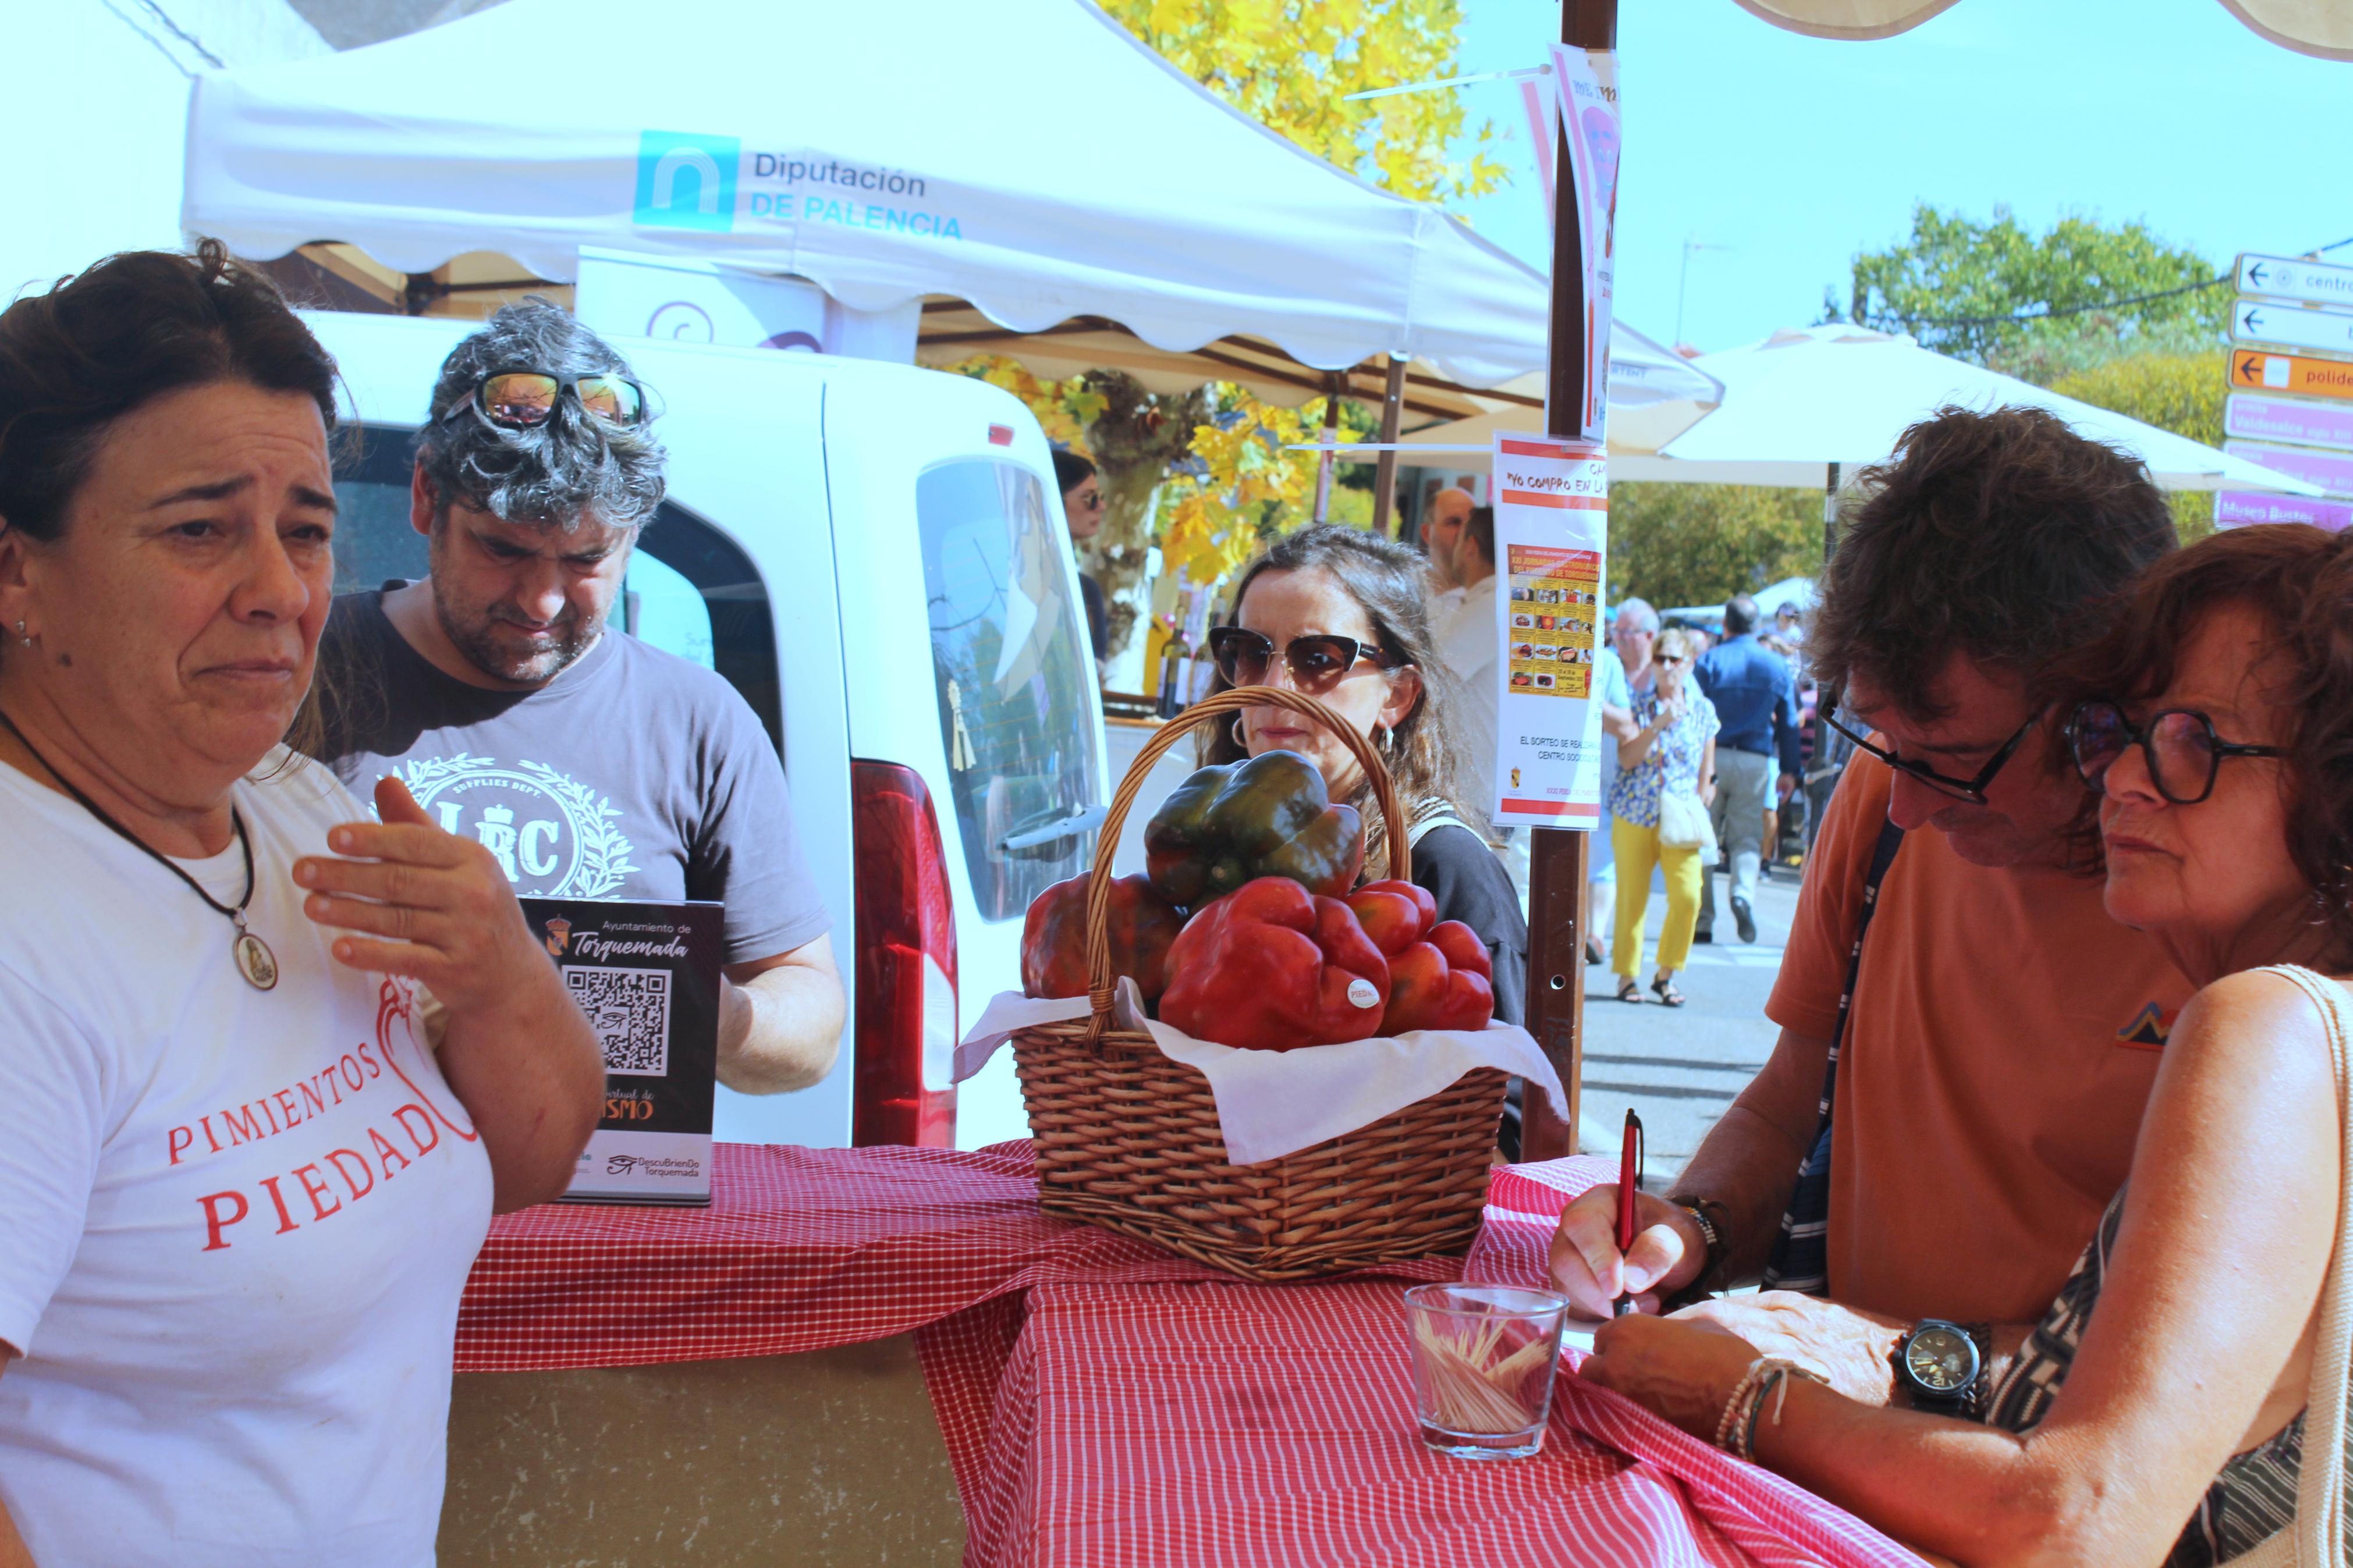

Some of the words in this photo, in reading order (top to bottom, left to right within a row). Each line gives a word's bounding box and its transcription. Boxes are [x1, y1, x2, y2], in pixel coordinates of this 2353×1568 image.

[755, 152, 927, 197] Diputación
[751, 193, 794, 219] DE
[804, 195, 963, 241] PALENCIA
[1527, 476, 1571, 490] COMPRO
[1520, 736, 1529, 745] EL
[1531, 737, 1559, 747] SORTEO
[1561, 739, 1568, 748] SE
[1538, 751, 1566, 761] CENTRO
[452, 778, 509, 794] SUPPLIES
[602, 920, 674, 934] Ayuntamiento
[677, 924, 691, 934] de
[572, 931, 689, 962] Torquemada
[642, 1090, 655, 1100] de
[168, 1042, 381, 1165] PIMIENTOS
[603, 1098, 653, 1119] ISMO
[196, 1103, 439, 1251] PIEDAD
[644, 1167, 699, 1178] Torquemada
